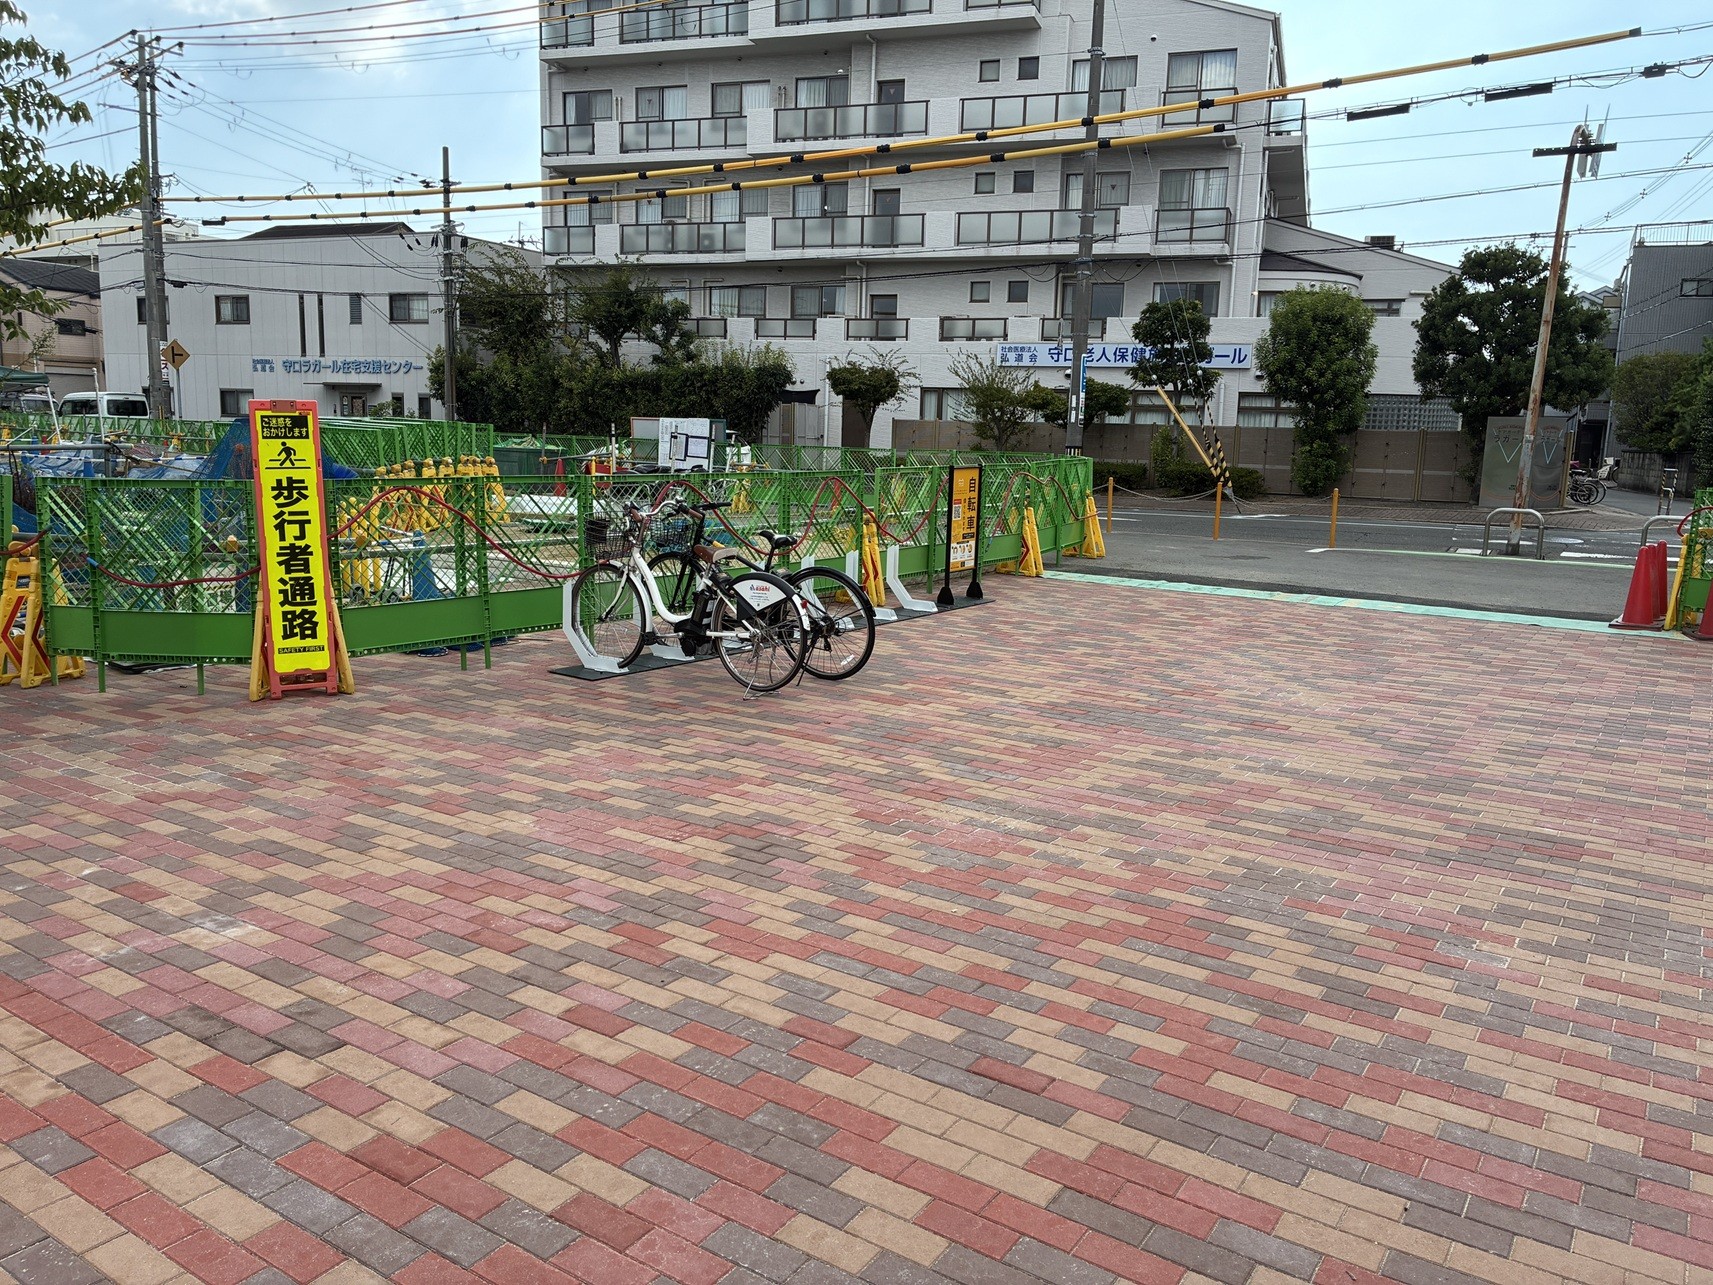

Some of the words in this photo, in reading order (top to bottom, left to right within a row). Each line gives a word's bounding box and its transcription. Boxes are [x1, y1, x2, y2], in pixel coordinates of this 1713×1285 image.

[1001, 353, 1038, 363] 弘道会
[282, 359, 424, 374] 守口ラガール在宅支援センター
[262, 417, 292, 428] ご迷惑を
[262, 427, 308, 437] おかけします
[966, 476, 977, 531] 自転車
[271, 476, 320, 641] 歩行者通路
